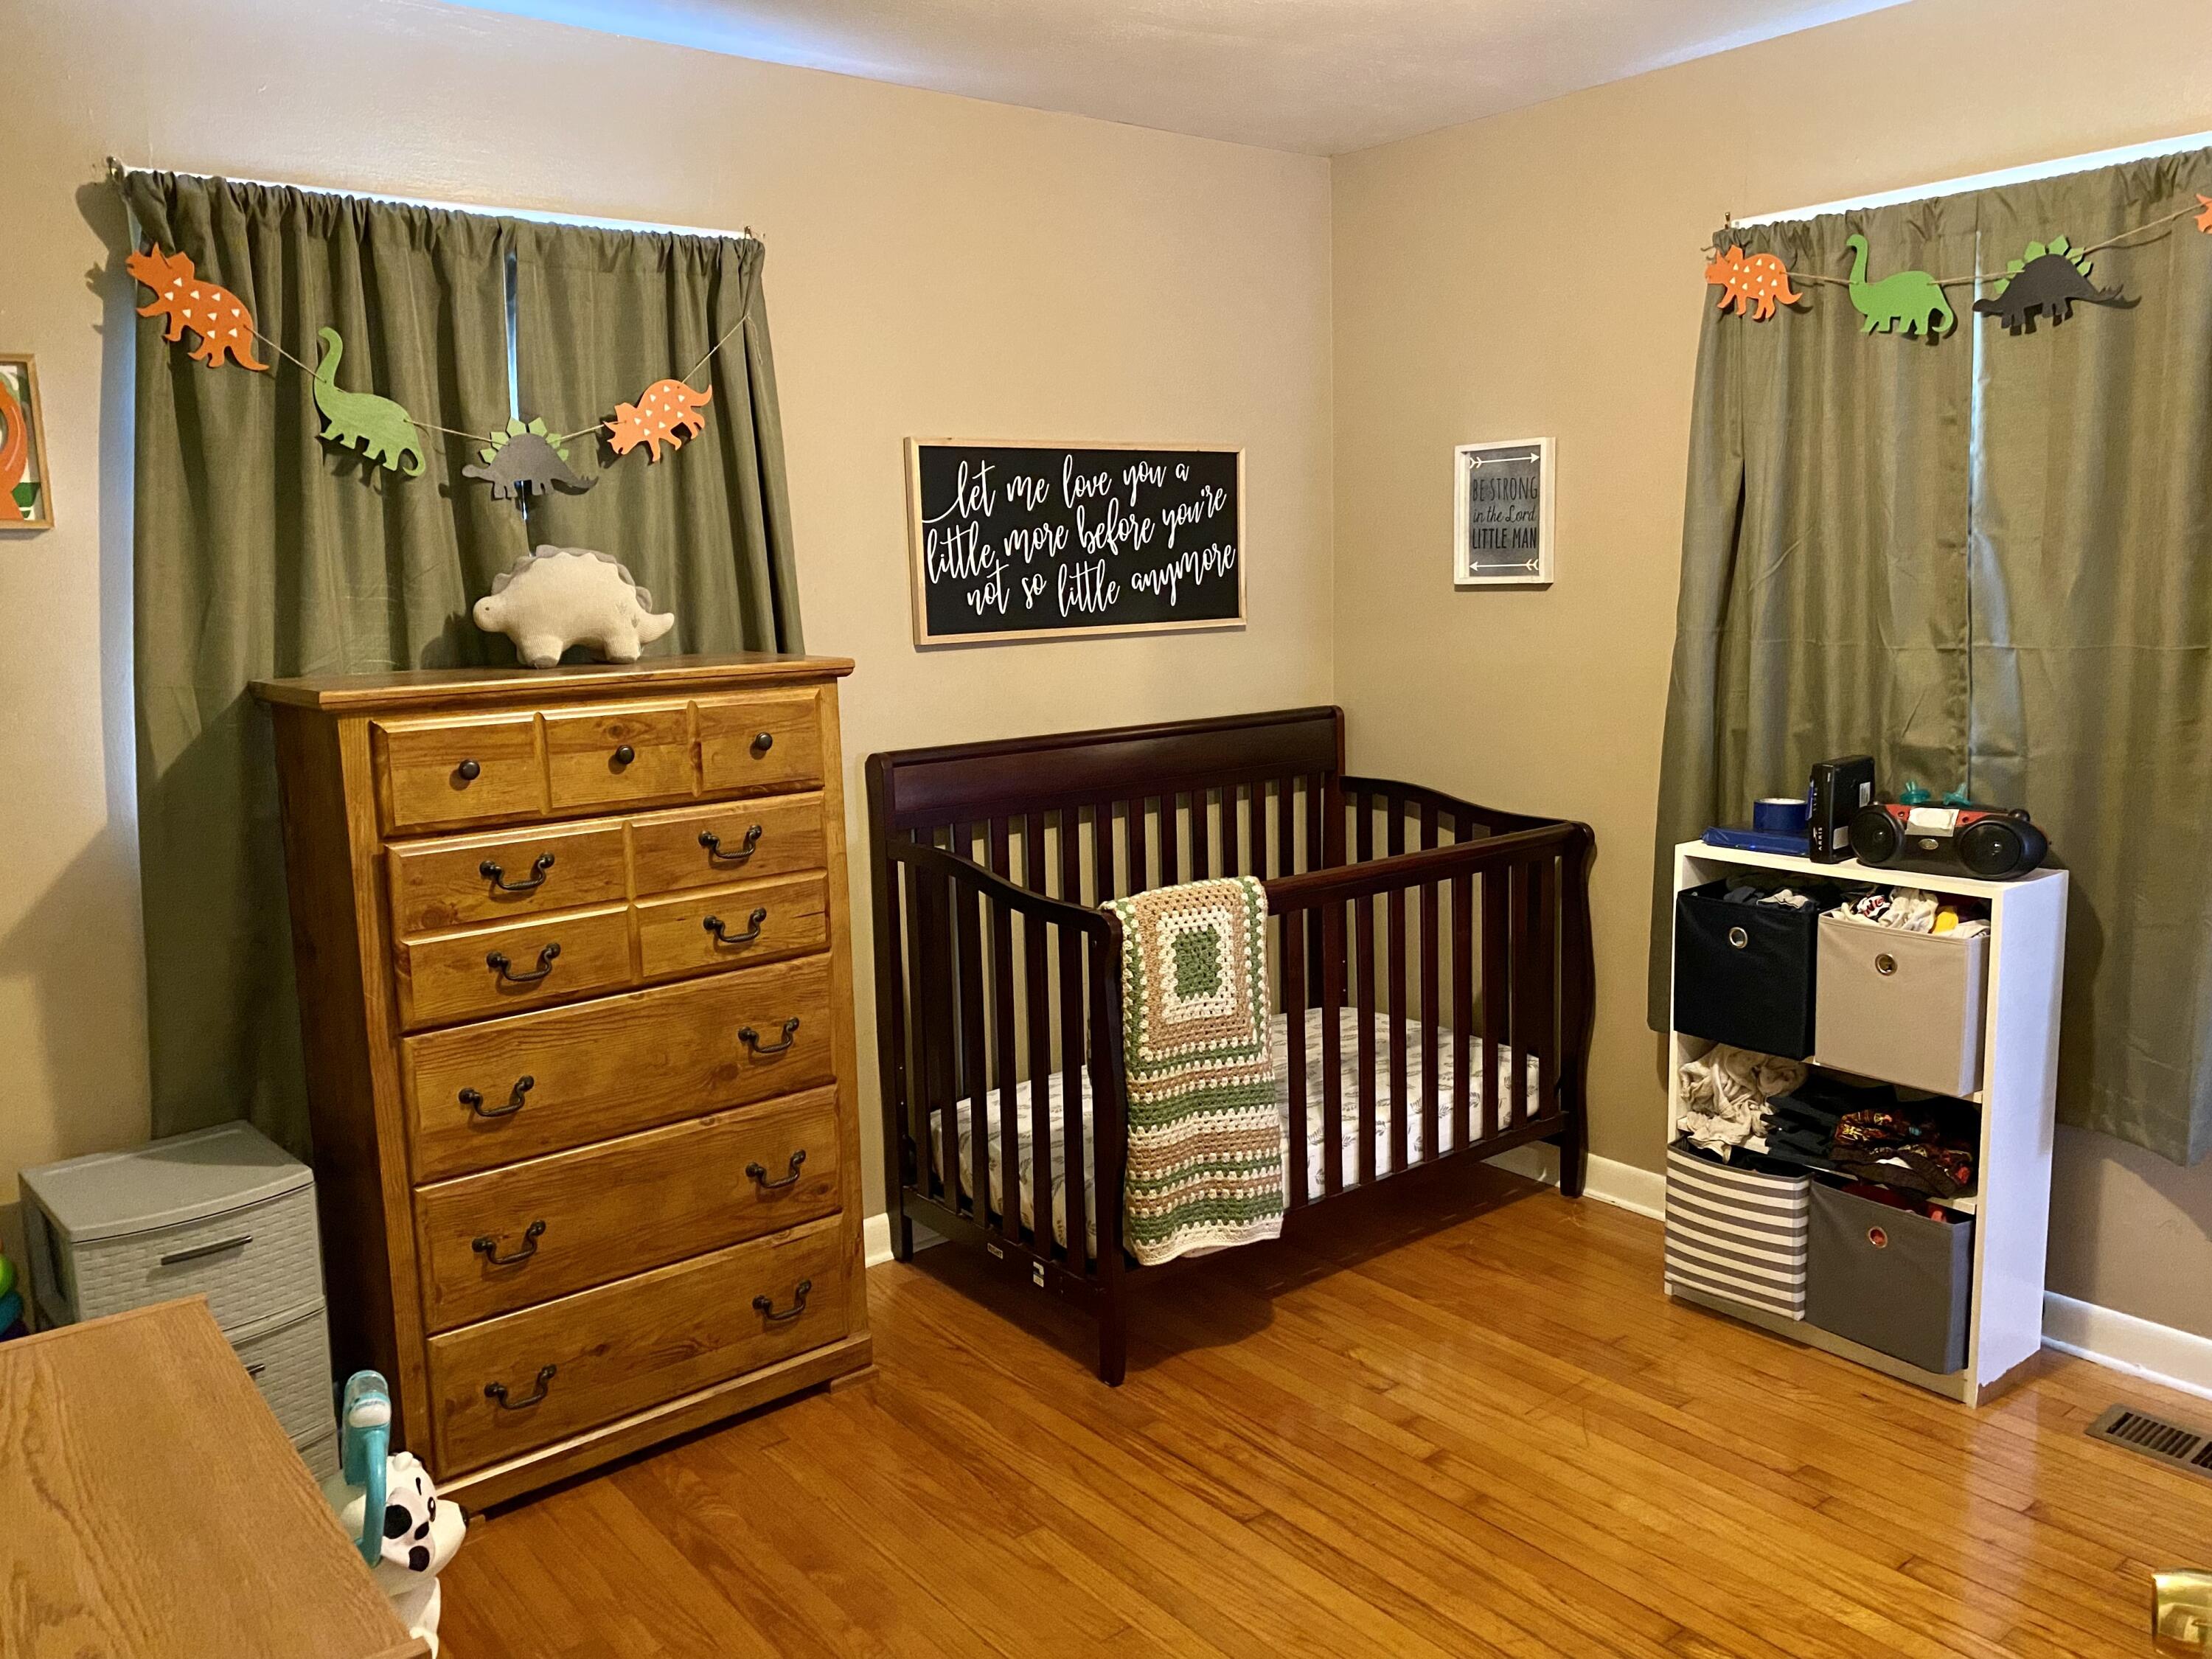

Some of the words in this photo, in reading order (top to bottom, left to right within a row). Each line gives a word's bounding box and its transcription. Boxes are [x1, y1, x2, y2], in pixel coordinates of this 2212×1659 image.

[1006, 476, 1050, 512] me
[1062, 454, 1113, 509] love
[1123, 461, 1167, 507] you
[1175, 463, 1190, 481] a
[1472, 479, 1485, 502] BE
[1490, 476, 1538, 501] STRONG
[927, 521, 996, 585] little
[1004, 522, 1069, 564] more
[1077, 497, 1155, 556] before
[1162, 484, 1228, 549] you're
[1473, 507, 1486, 524] in
[1486, 505, 1503, 523] the
[1505, 504, 1537, 524] Lord
[1472, 528, 1508, 549] LITTLE
[1512, 526, 1537, 549] MAN
[967, 559, 1010, 616] not
[1021, 573, 1047, 610] so
[1057, 558, 1121, 618] little
[1131, 543, 1237, 607] anymore
